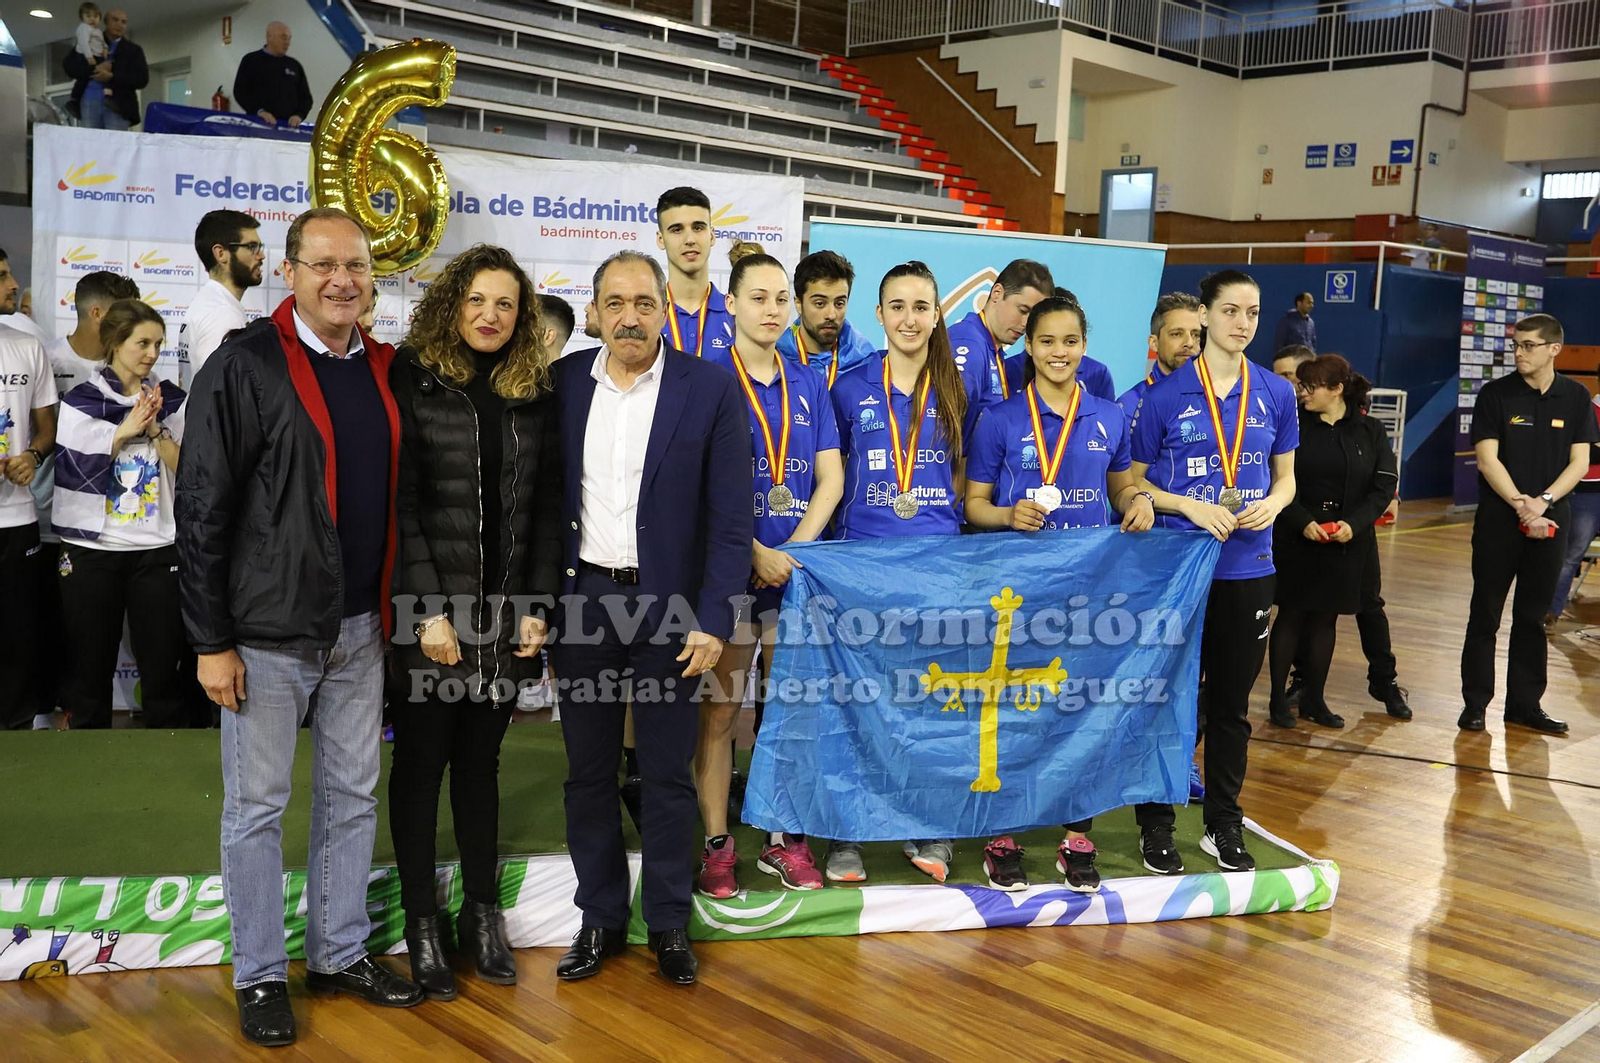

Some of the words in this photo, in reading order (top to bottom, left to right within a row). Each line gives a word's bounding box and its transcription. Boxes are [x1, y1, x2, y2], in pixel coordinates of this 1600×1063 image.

[73, 189, 155, 205] BADMINTON
[488, 193, 524, 217] de
[540, 225, 637, 242] badminton.es
[862, 420, 885, 432] ovida
[1182, 431, 1207, 443] ovida
